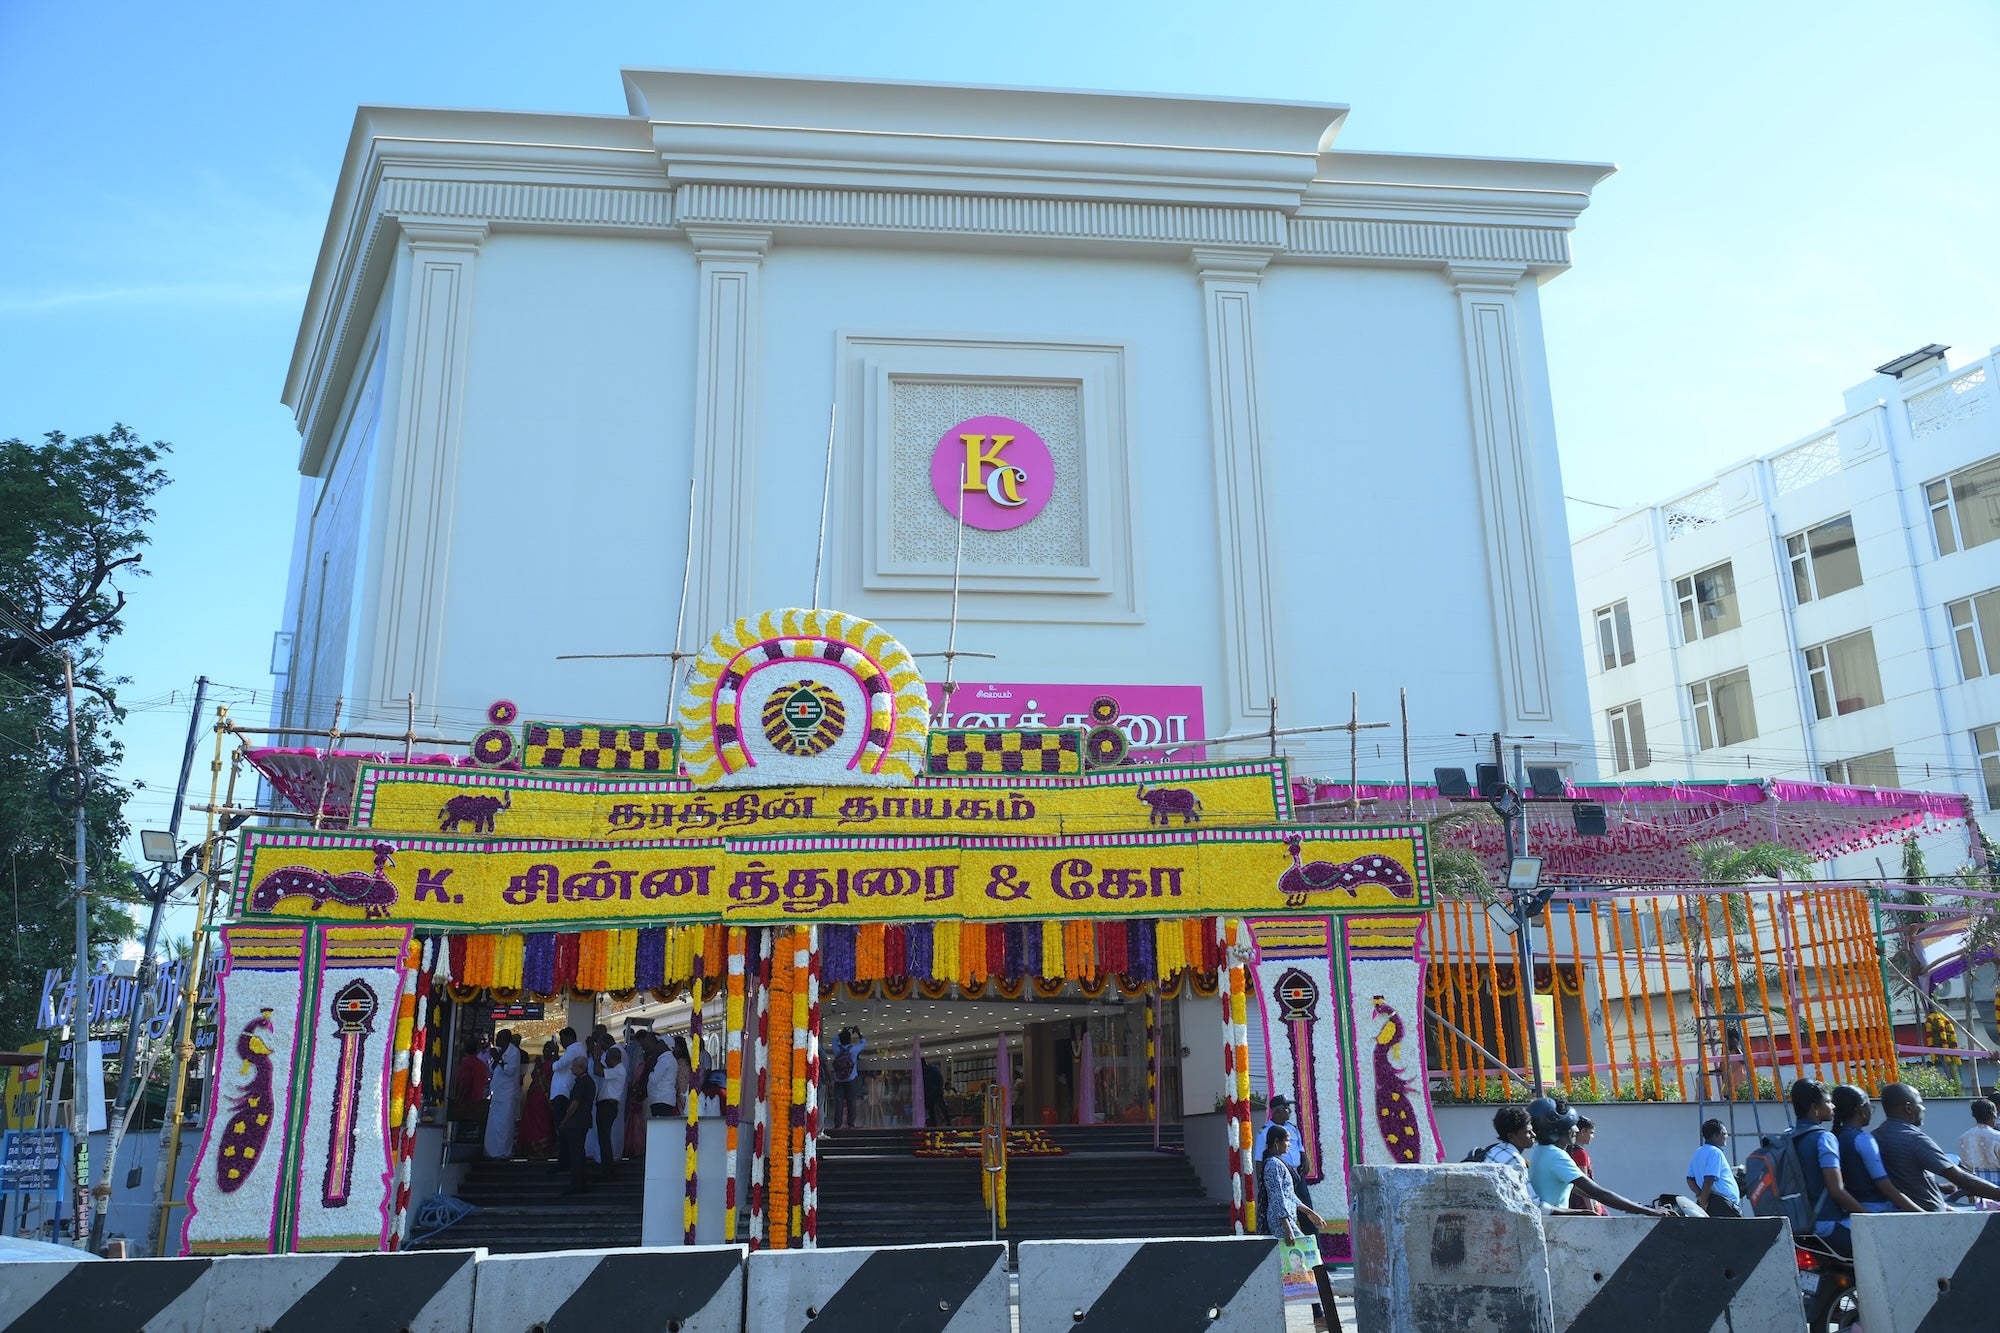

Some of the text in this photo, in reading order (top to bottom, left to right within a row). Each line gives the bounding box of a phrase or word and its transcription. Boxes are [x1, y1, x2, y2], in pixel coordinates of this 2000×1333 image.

[605, 791, 1035, 836] தரத்தின் தாயகம்
[414, 868, 464, 904] K.
[985, 864, 1032, 901] &
[1051, 858, 1184, 900] கோ
